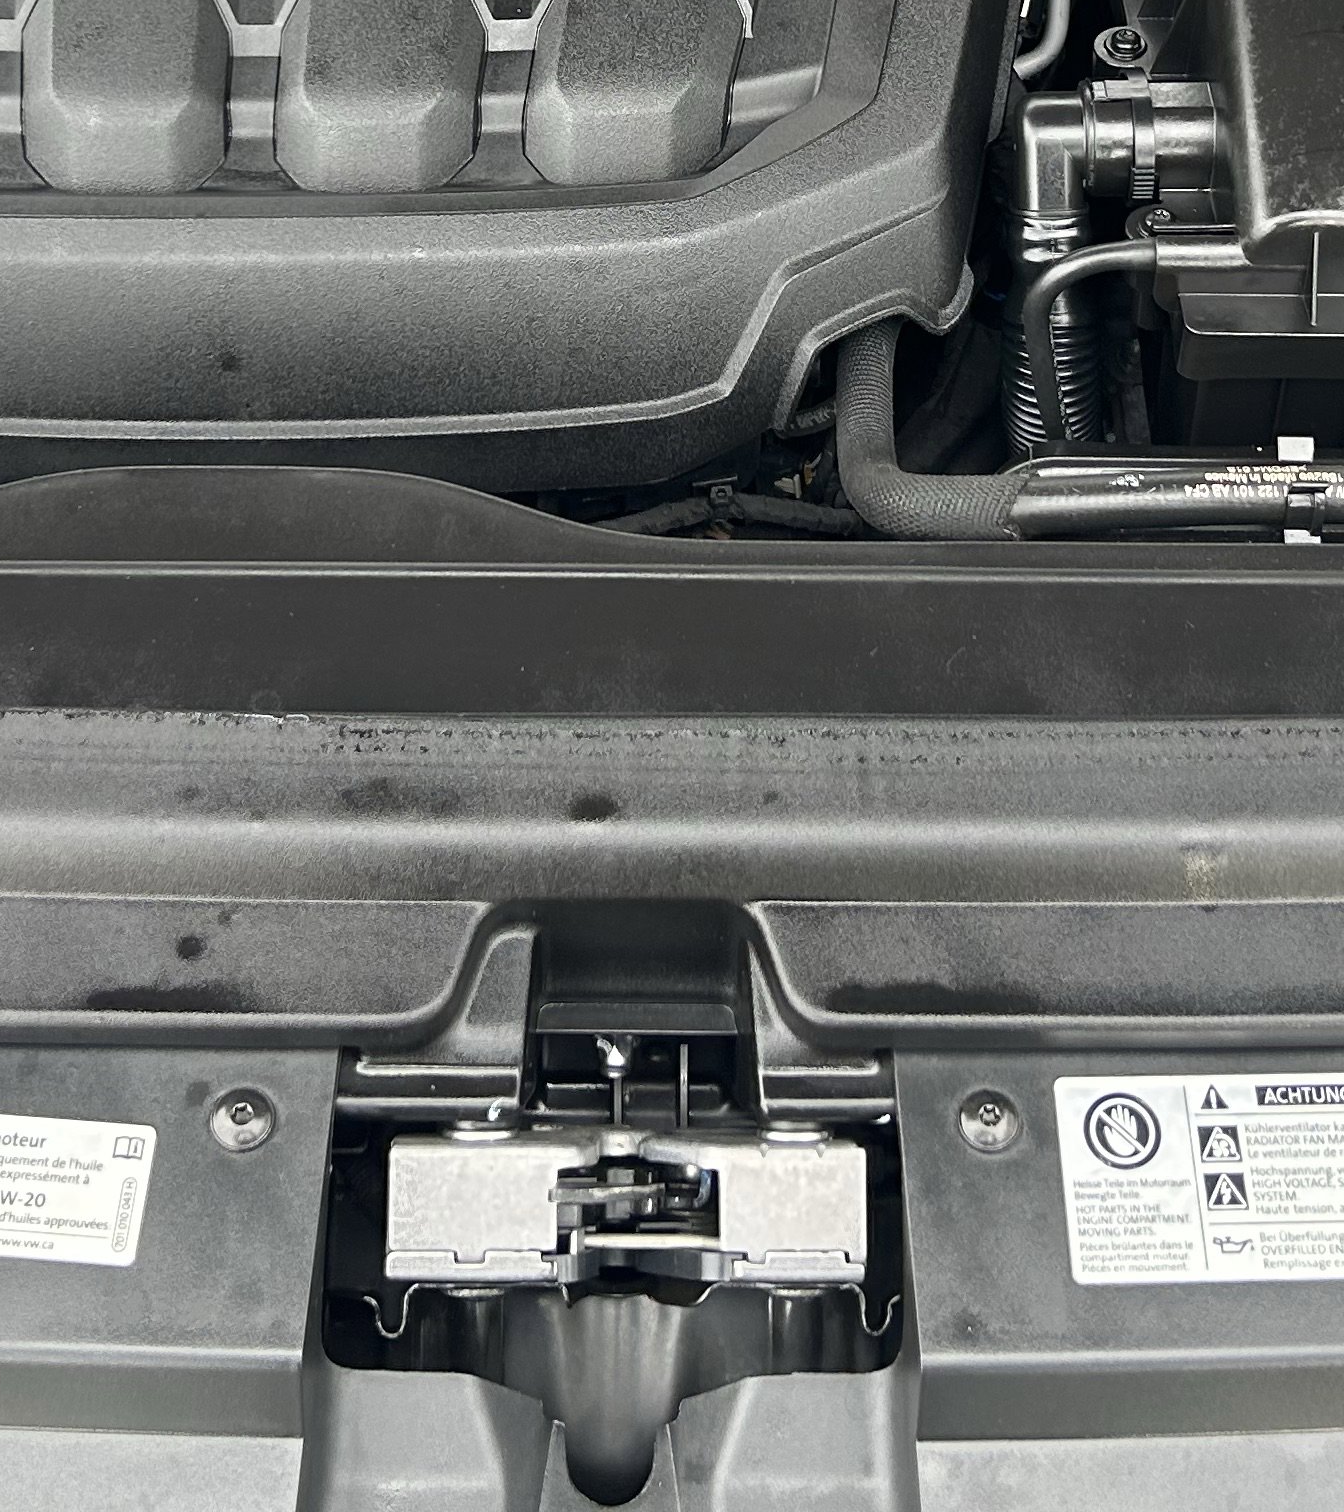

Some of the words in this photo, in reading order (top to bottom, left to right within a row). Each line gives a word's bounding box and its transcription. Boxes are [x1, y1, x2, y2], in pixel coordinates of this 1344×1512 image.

[1232, 484, 1255, 498] 101
[1256, 484, 1280, 498] 122
[1246, 1134, 1300, 1146] RADIATOR
[1303, 1134, 1325, 1144] FAN
[51, 1157, 66, 1168] de
[1251, 1178, 1281, 1189] HIGH
